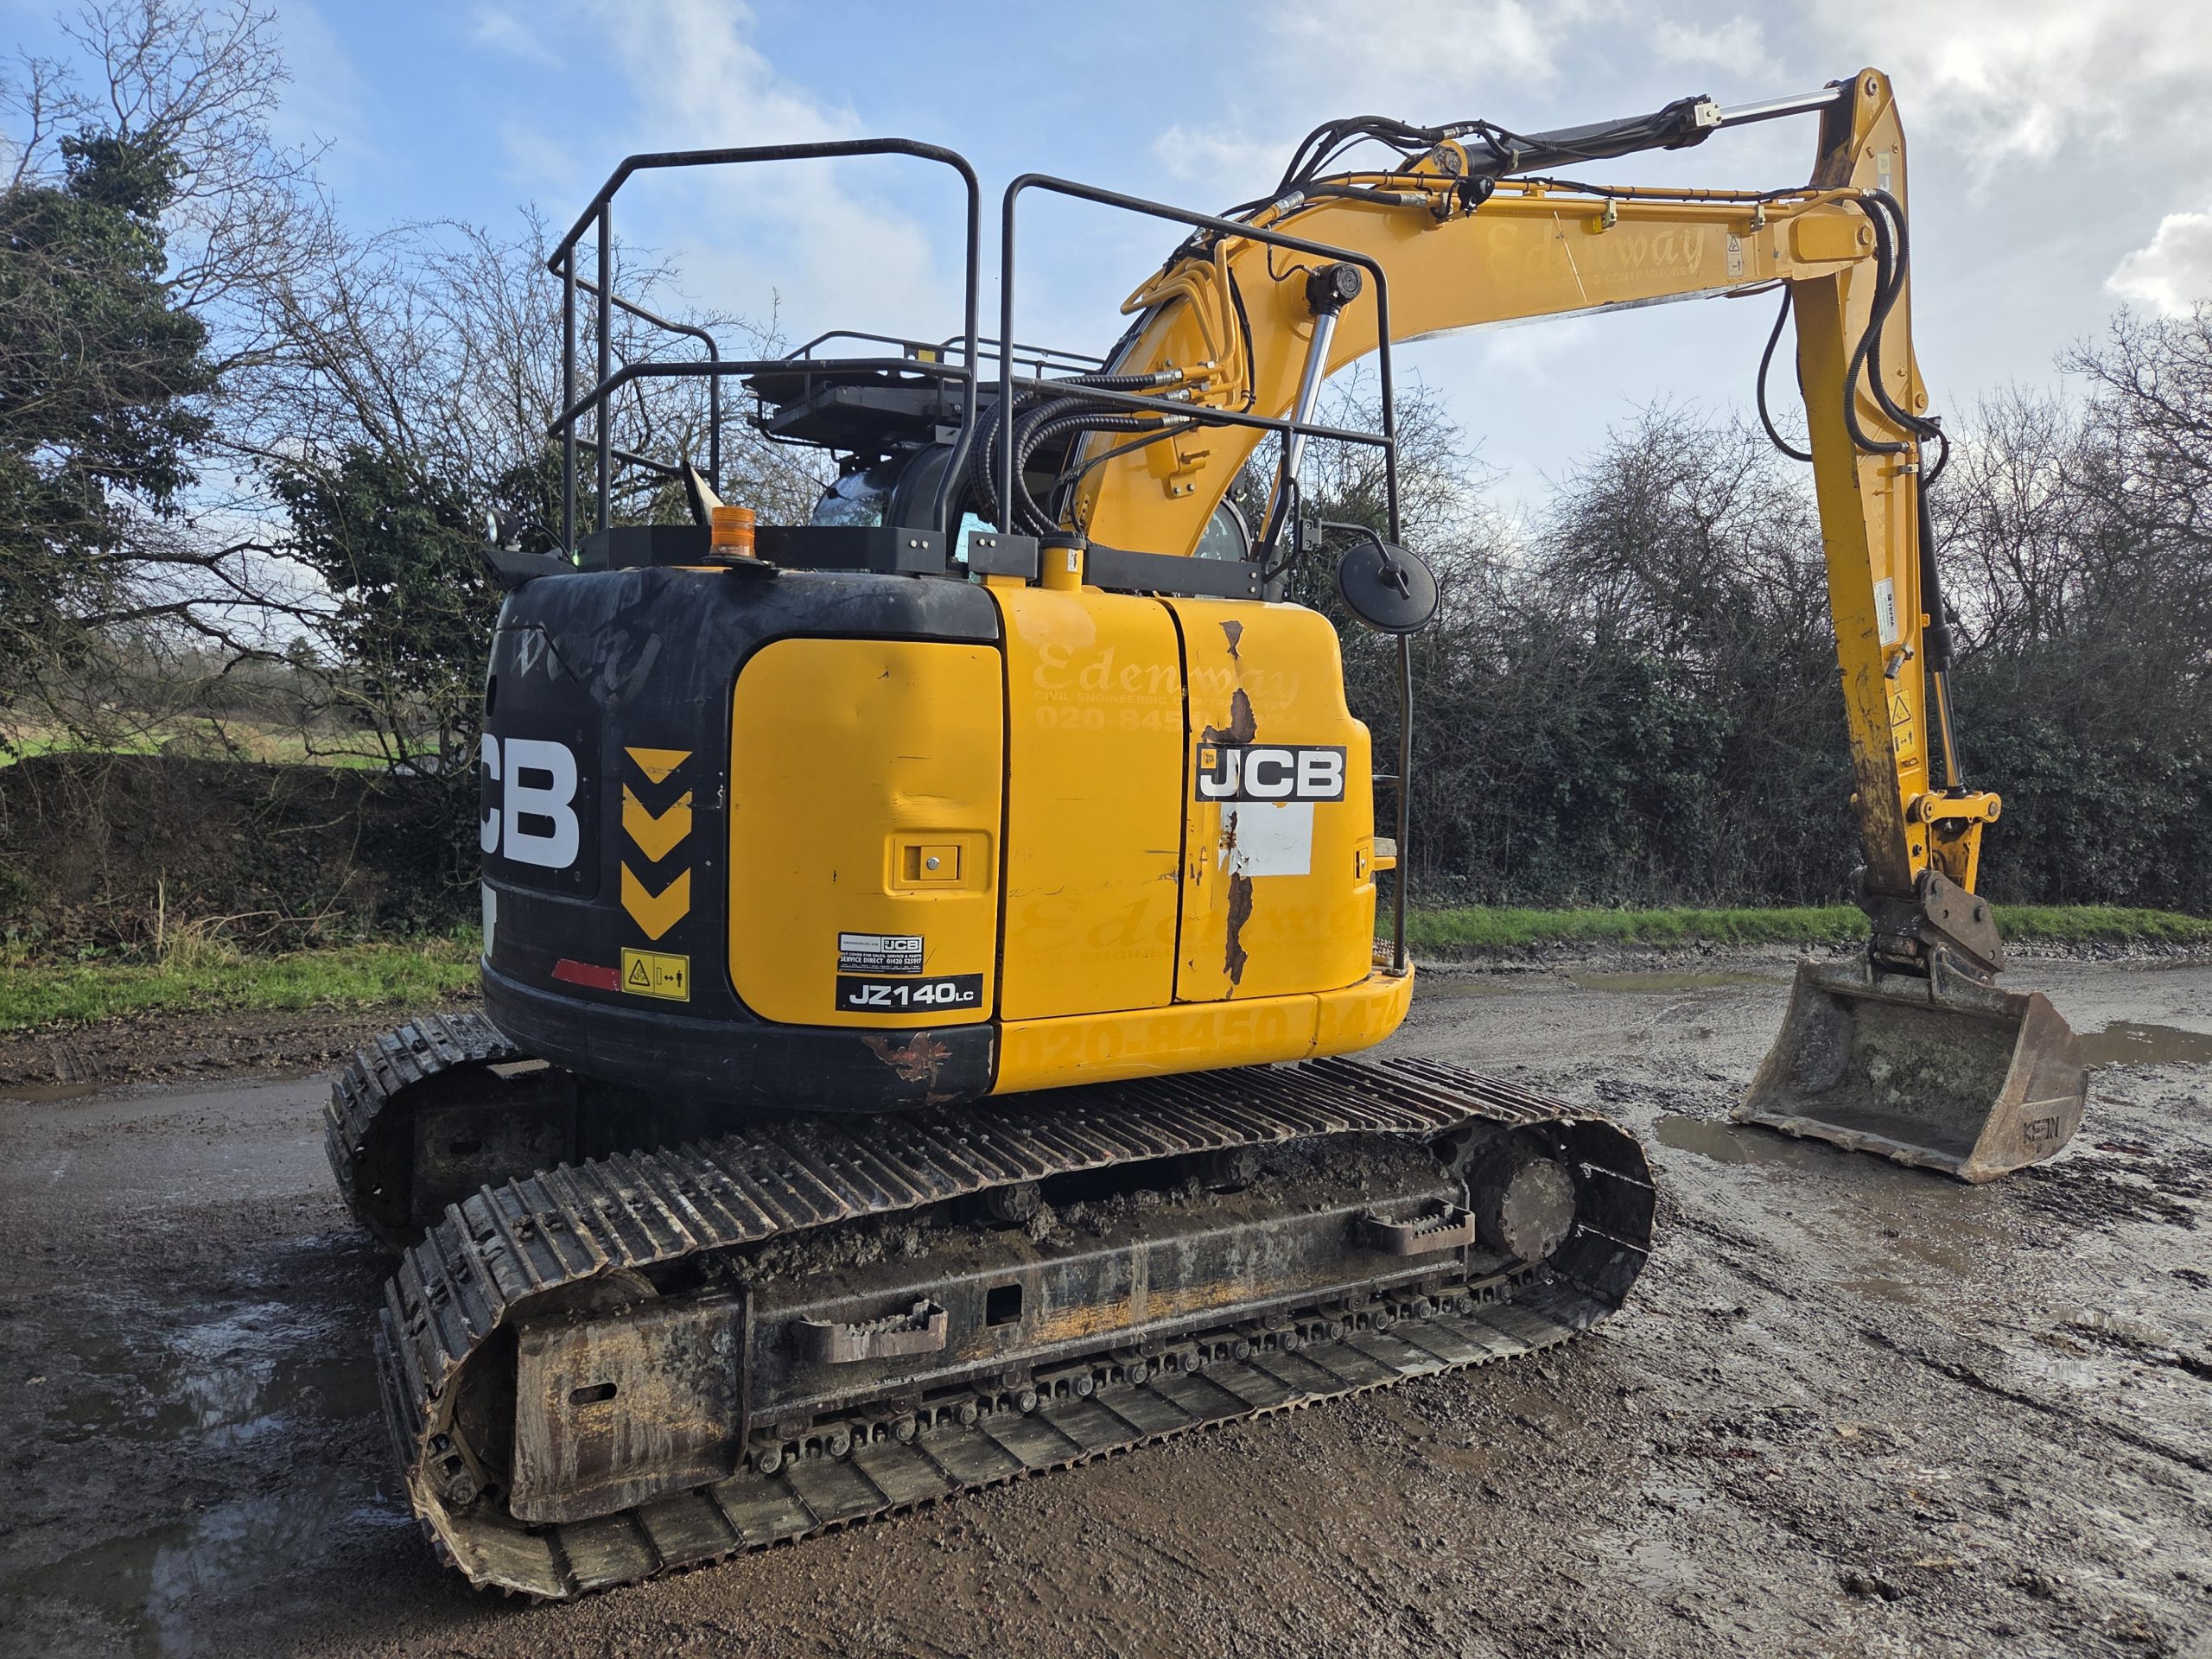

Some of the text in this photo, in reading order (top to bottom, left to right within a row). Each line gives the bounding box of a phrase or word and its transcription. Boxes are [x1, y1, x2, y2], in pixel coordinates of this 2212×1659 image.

[1033, 642, 1302, 709] Edenway
[1034, 690, 1278, 710] CIVIL ENGINEERING CONTRAORS
[1199, 748, 1344, 798] JCB
[884, 940, 919, 950] JCB
